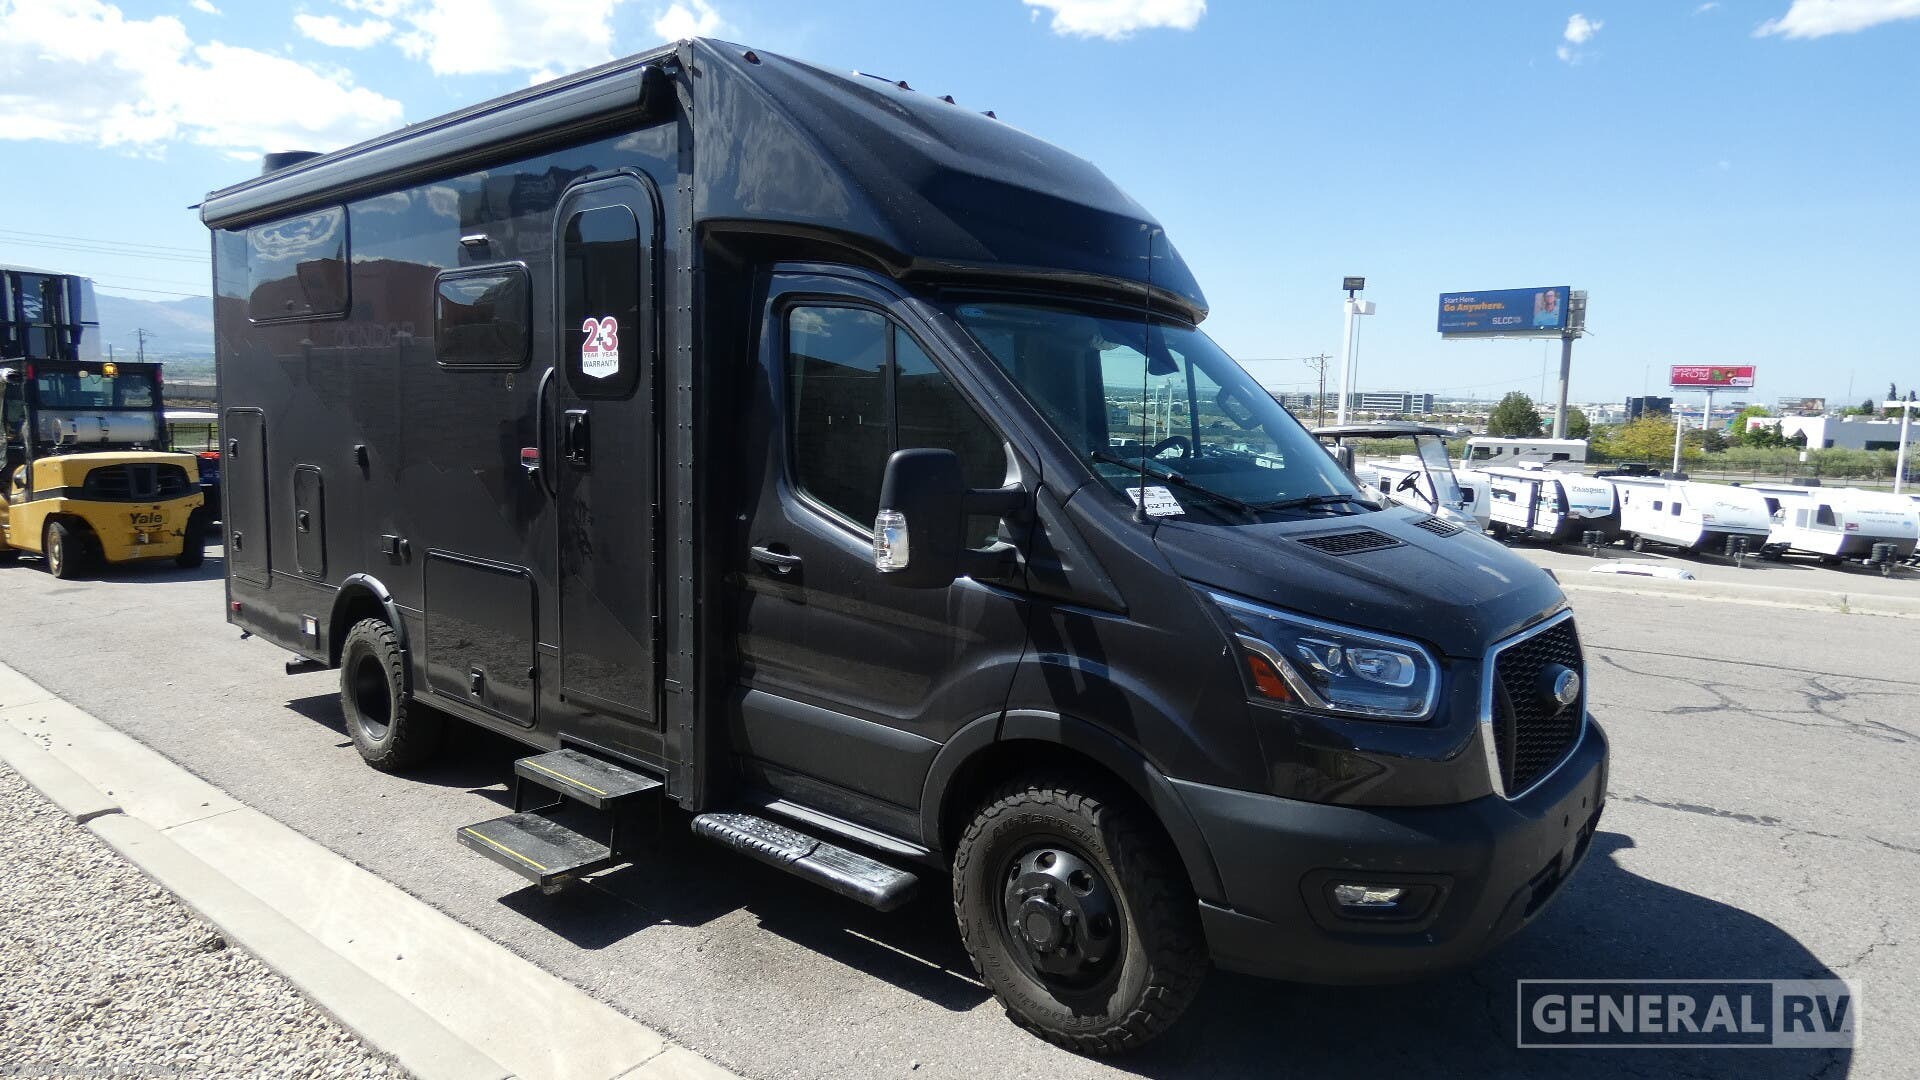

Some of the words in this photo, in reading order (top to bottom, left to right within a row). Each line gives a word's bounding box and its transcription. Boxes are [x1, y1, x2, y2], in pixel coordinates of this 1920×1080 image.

[1457, 302, 1505, 312] Anywhere.
[1492, 317, 1514, 325] SLCC
[583, 359, 617, 368] WARRANTY
[129, 512, 163, 524] Yale
